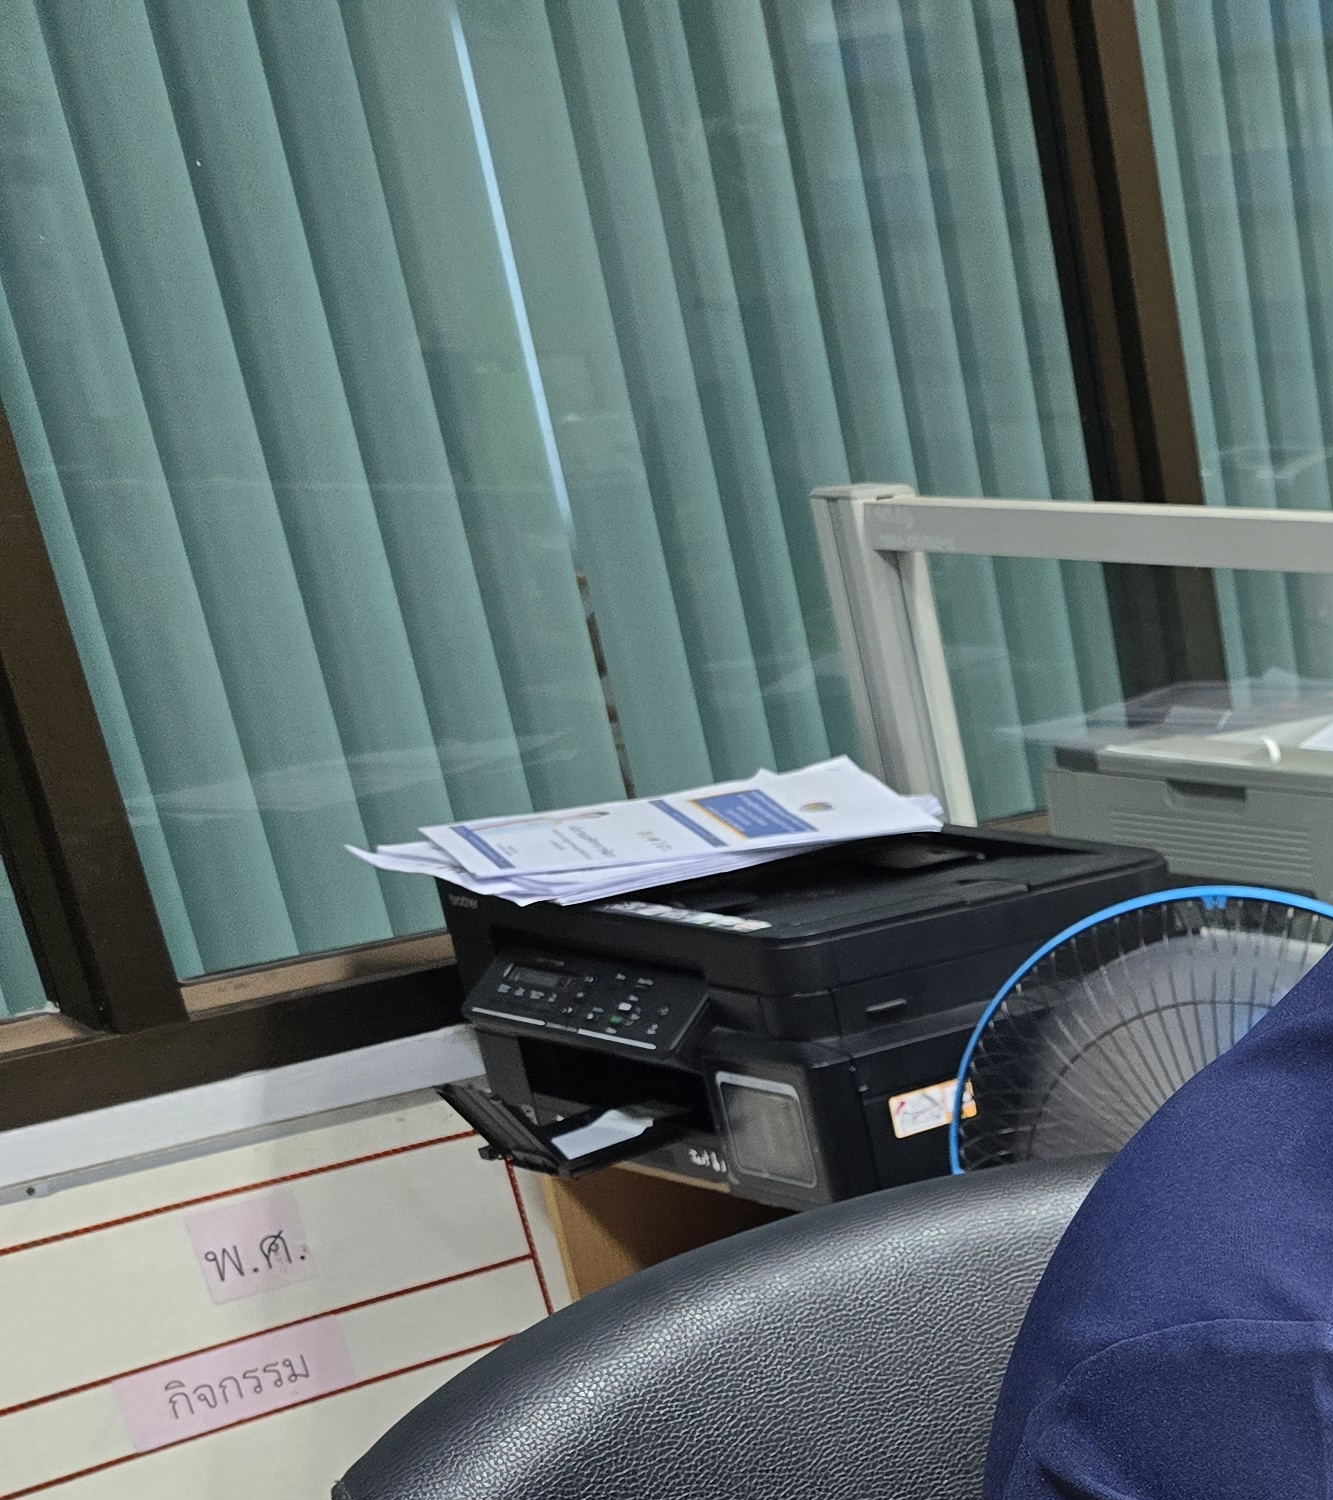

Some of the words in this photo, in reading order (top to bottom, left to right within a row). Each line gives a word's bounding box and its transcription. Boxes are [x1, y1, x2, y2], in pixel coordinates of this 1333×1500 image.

[204, 1229, 308, 1283] พ.ศ.
[163, 1352, 311, 1421] กิจกรรม
